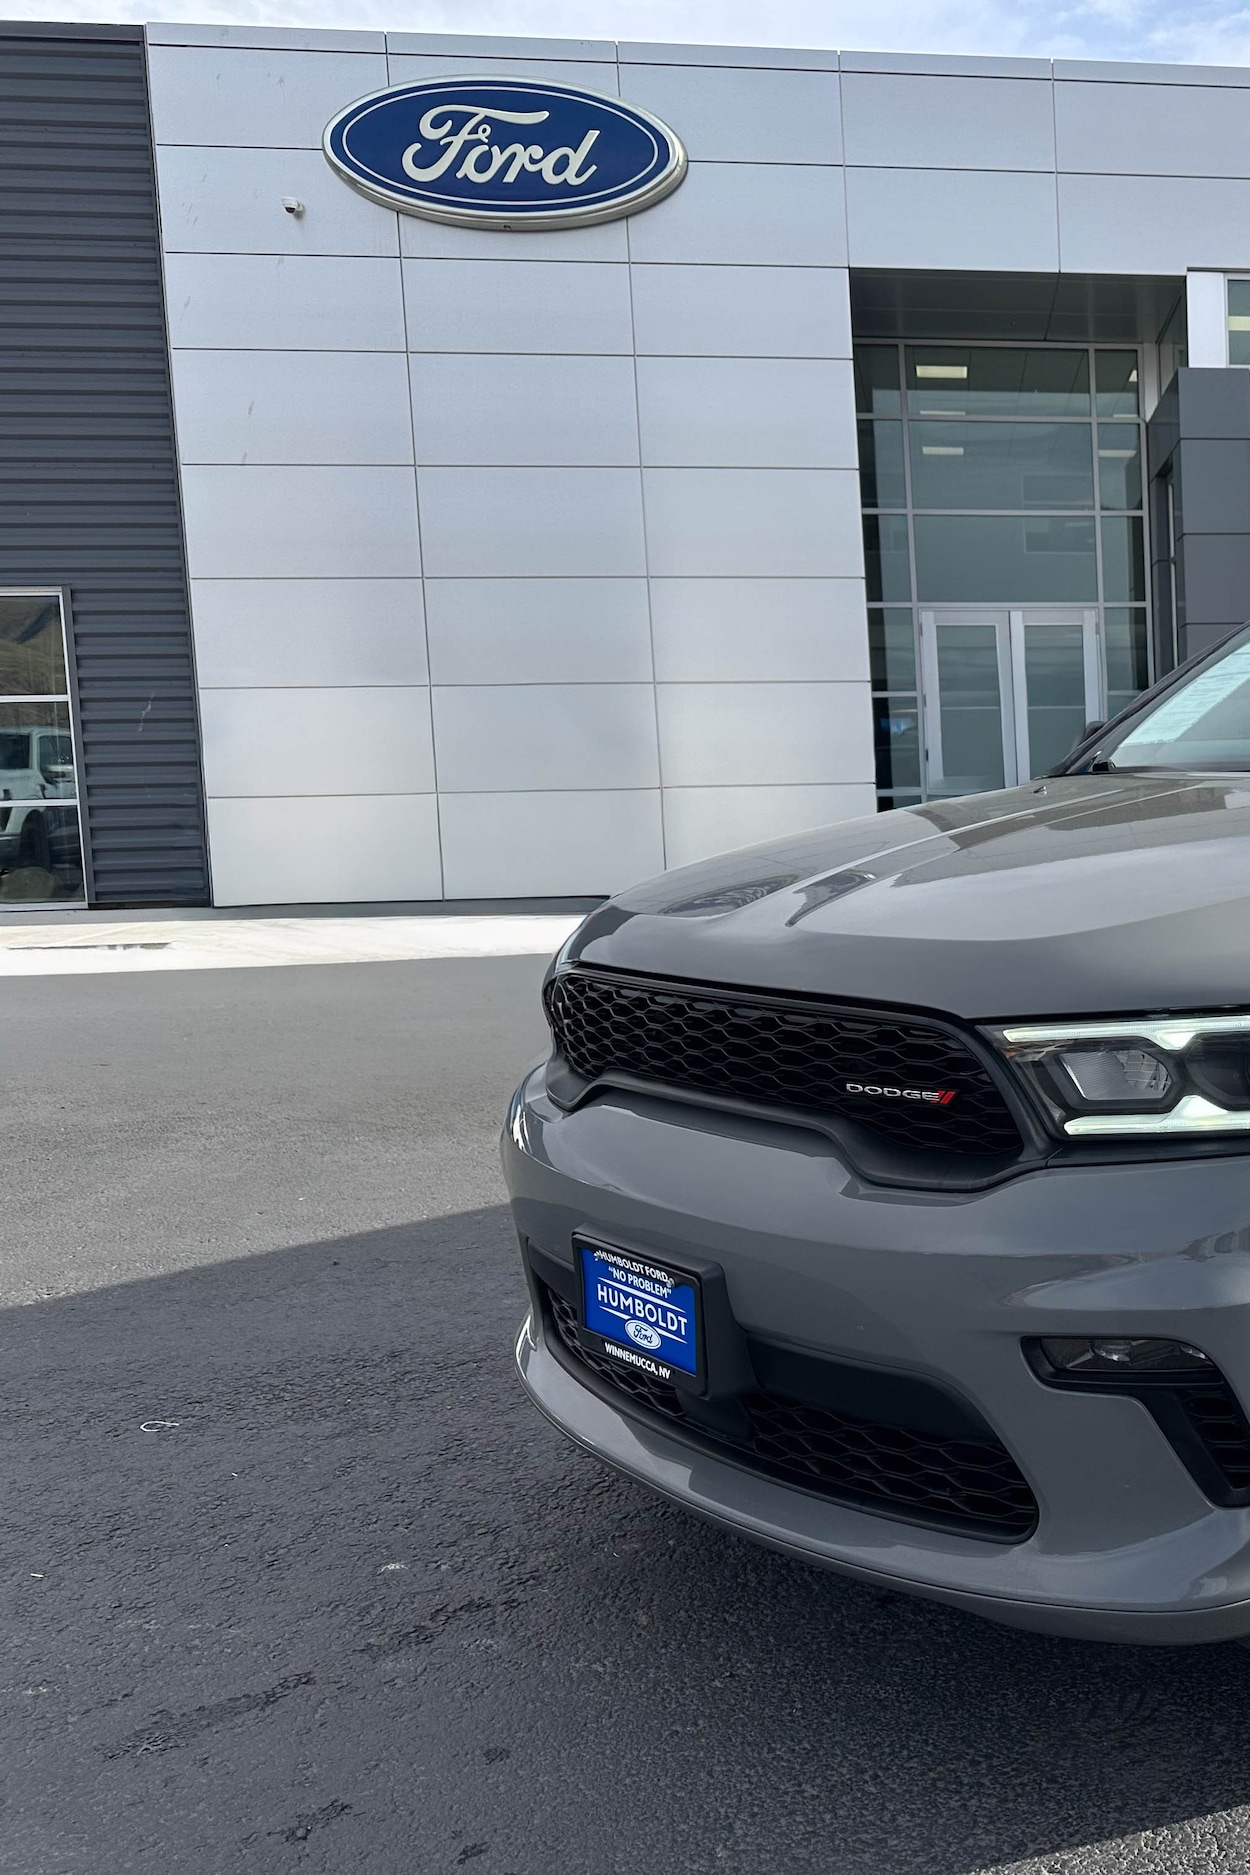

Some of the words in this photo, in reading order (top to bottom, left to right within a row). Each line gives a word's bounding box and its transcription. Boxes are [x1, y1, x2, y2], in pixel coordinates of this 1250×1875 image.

[402, 105, 600, 185] Ford
[846, 1083, 940, 1101] DODGE
[598, 1250, 645, 1274] HUMBOLDT
[644, 1266, 668, 1283] FORD
[597, 1284, 688, 1336] HUMBOLDT
[633, 1324, 653, 1344] Ford
[605, 1342, 659, 1376] WINNEMUCCA,
[659, 1366, 671, 1380] NV
